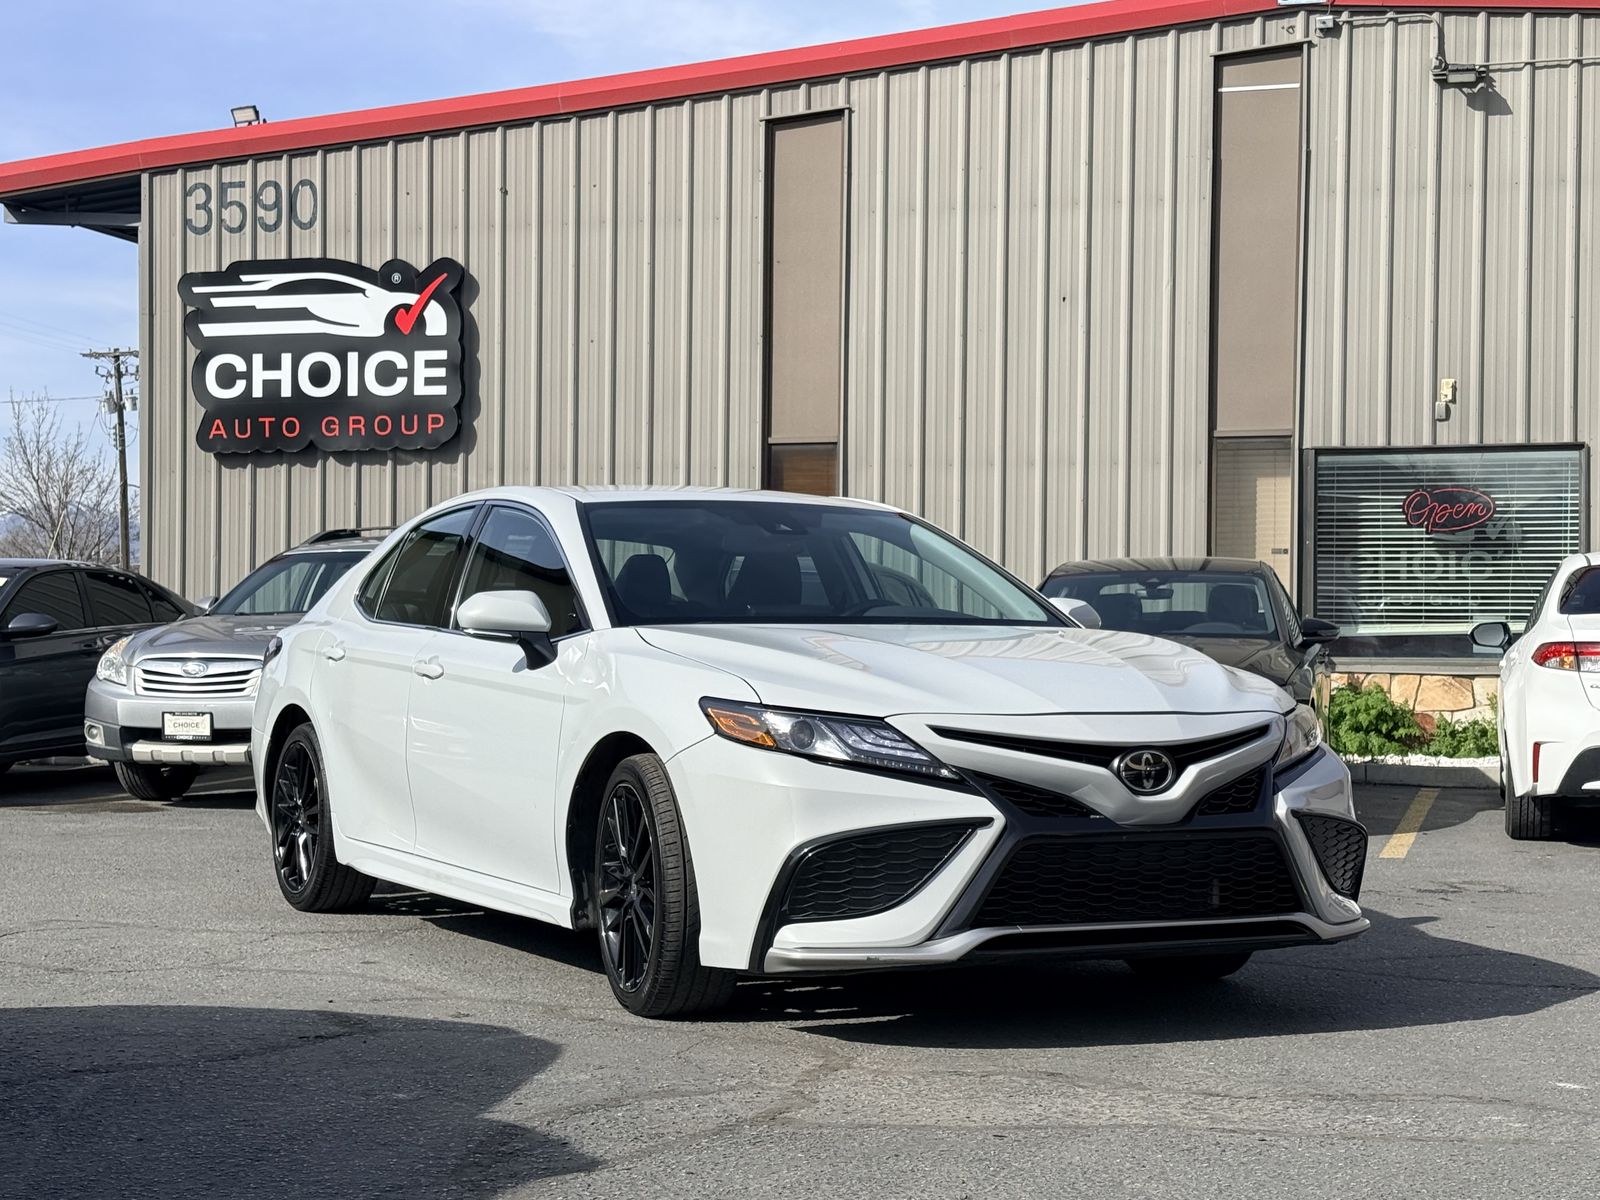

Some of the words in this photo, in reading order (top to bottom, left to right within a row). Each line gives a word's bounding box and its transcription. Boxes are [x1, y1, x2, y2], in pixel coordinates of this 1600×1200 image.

[185, 179, 318, 235] 3590
[205, 350, 448, 399] CHOICE
[209, 417, 301, 439] AUTO
[321, 413, 446, 437] GROUP
[1404, 491, 1487, 533] Open
[1343, 549, 1504, 582] CHOIC
